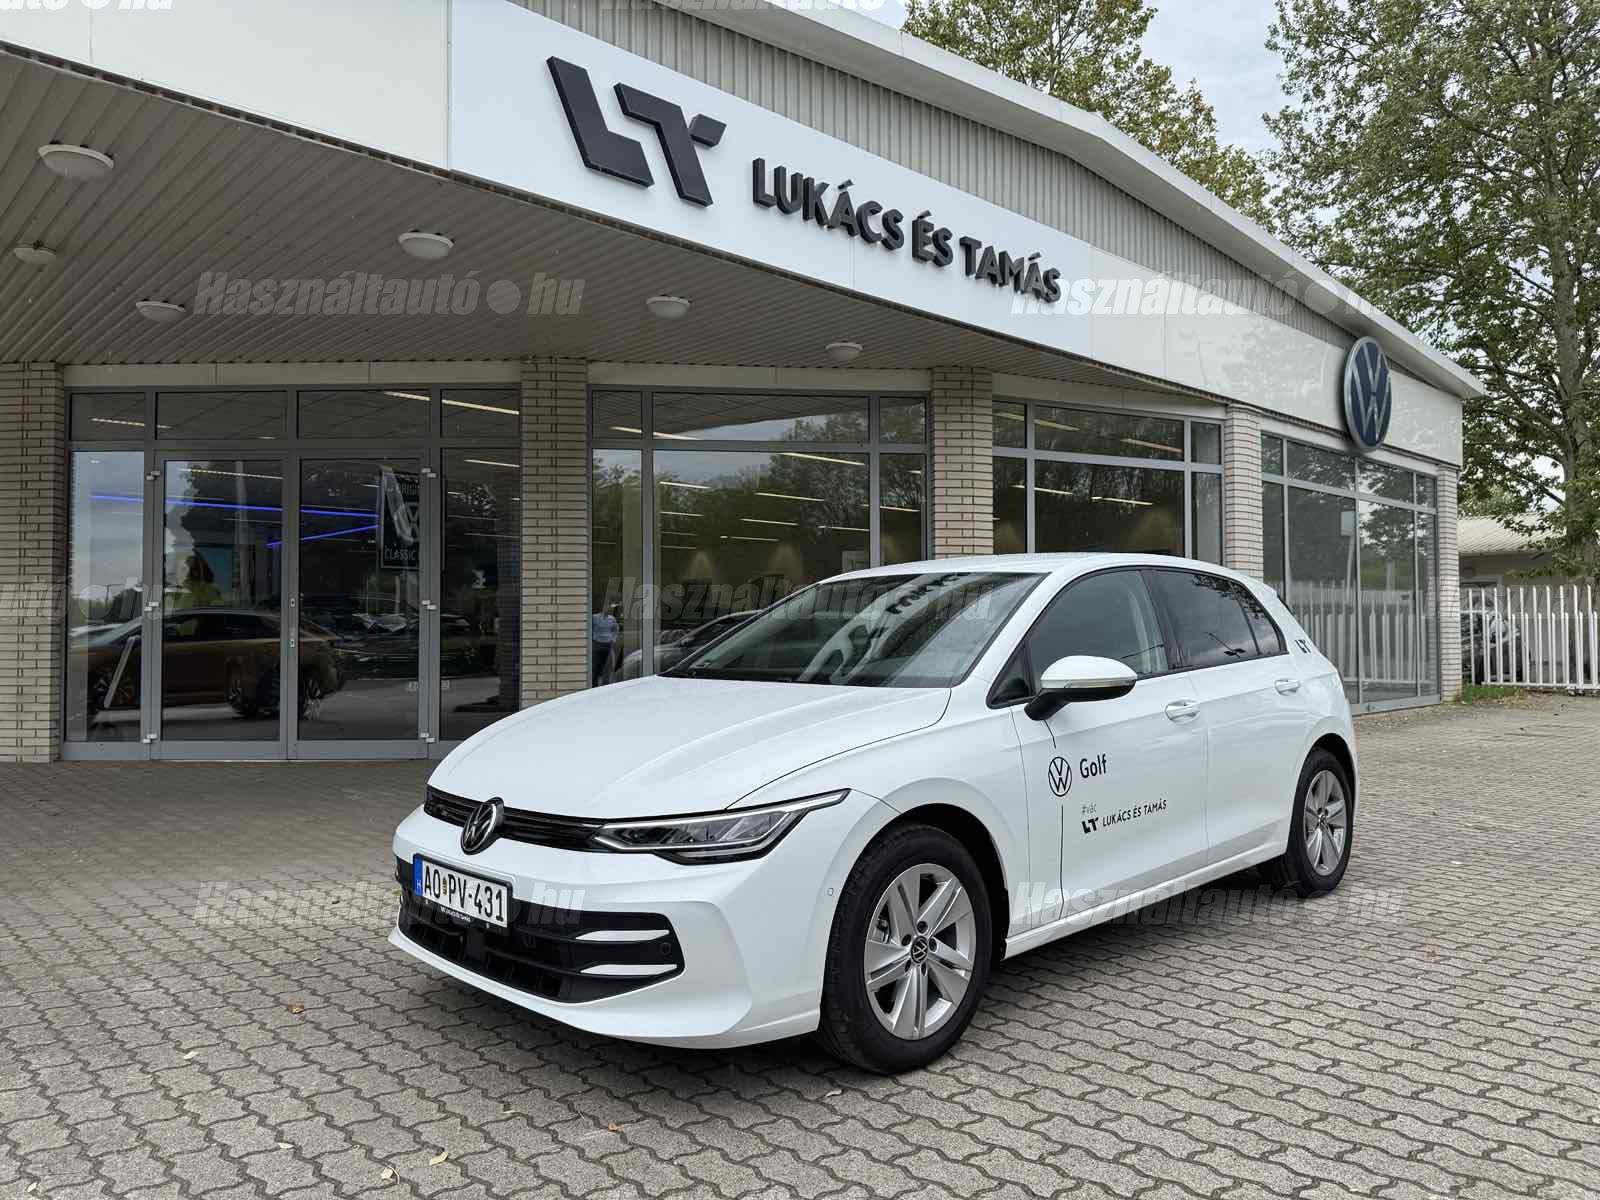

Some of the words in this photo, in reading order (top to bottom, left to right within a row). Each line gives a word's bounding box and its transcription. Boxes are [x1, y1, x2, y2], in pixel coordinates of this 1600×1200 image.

[546, 56, 727, 207] LT
[753, 157, 904, 251] LUKÁCS
[911, 210, 953, 267] ÉS
[960, 235, 1061, 304] TAMÁS
[1080, 754, 1107, 779] Golf
[1102, 809, 1131, 827] LUKÁCS
[1133, 805, 1141, 818] ÉS
[1144, 798, 1167, 816] TAMÁS
